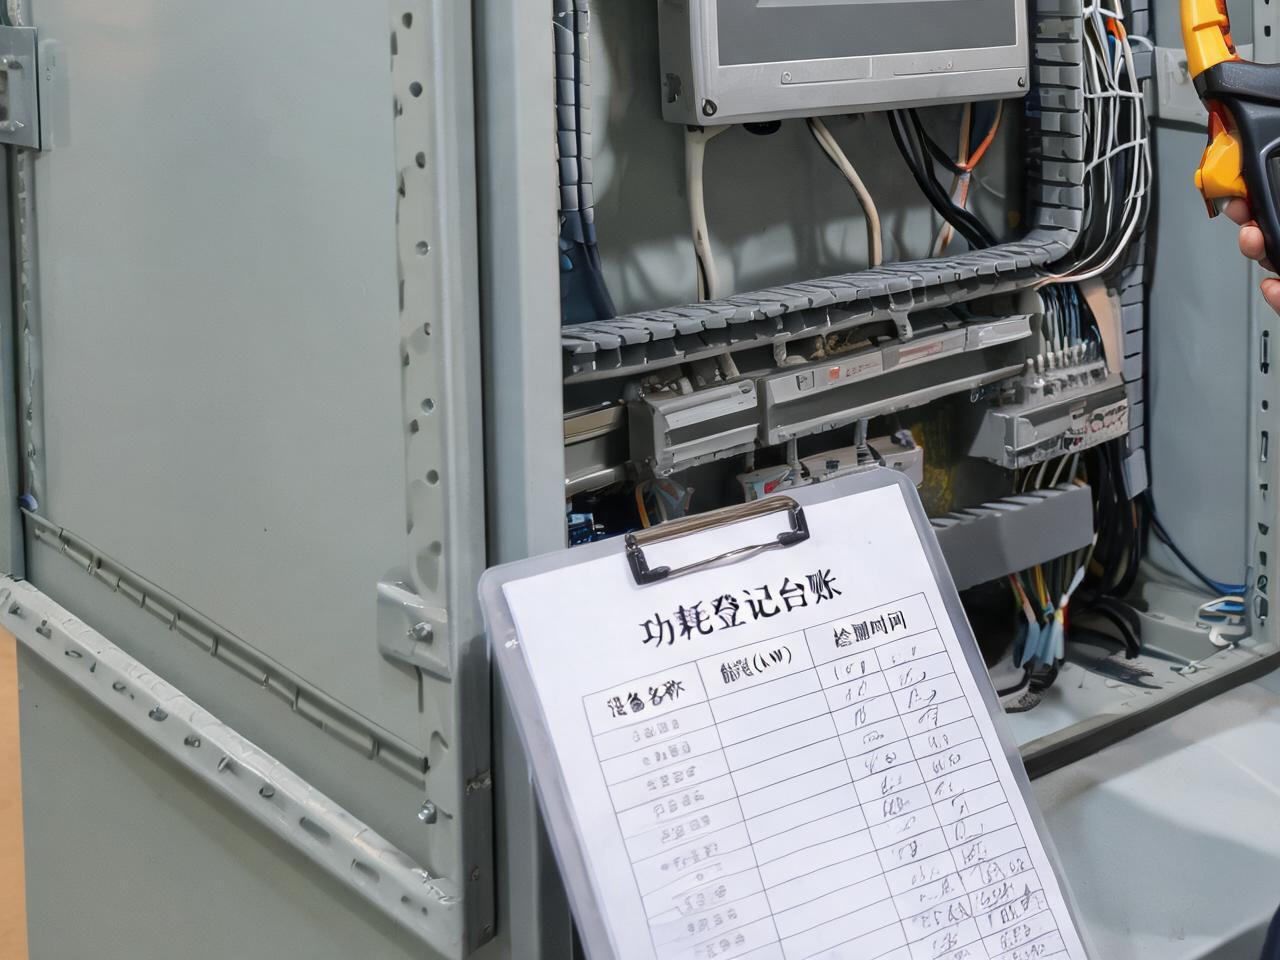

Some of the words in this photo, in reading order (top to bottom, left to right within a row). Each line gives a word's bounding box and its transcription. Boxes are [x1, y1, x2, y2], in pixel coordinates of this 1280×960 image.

[638, 568, 842, 648] 功耗登记台账
